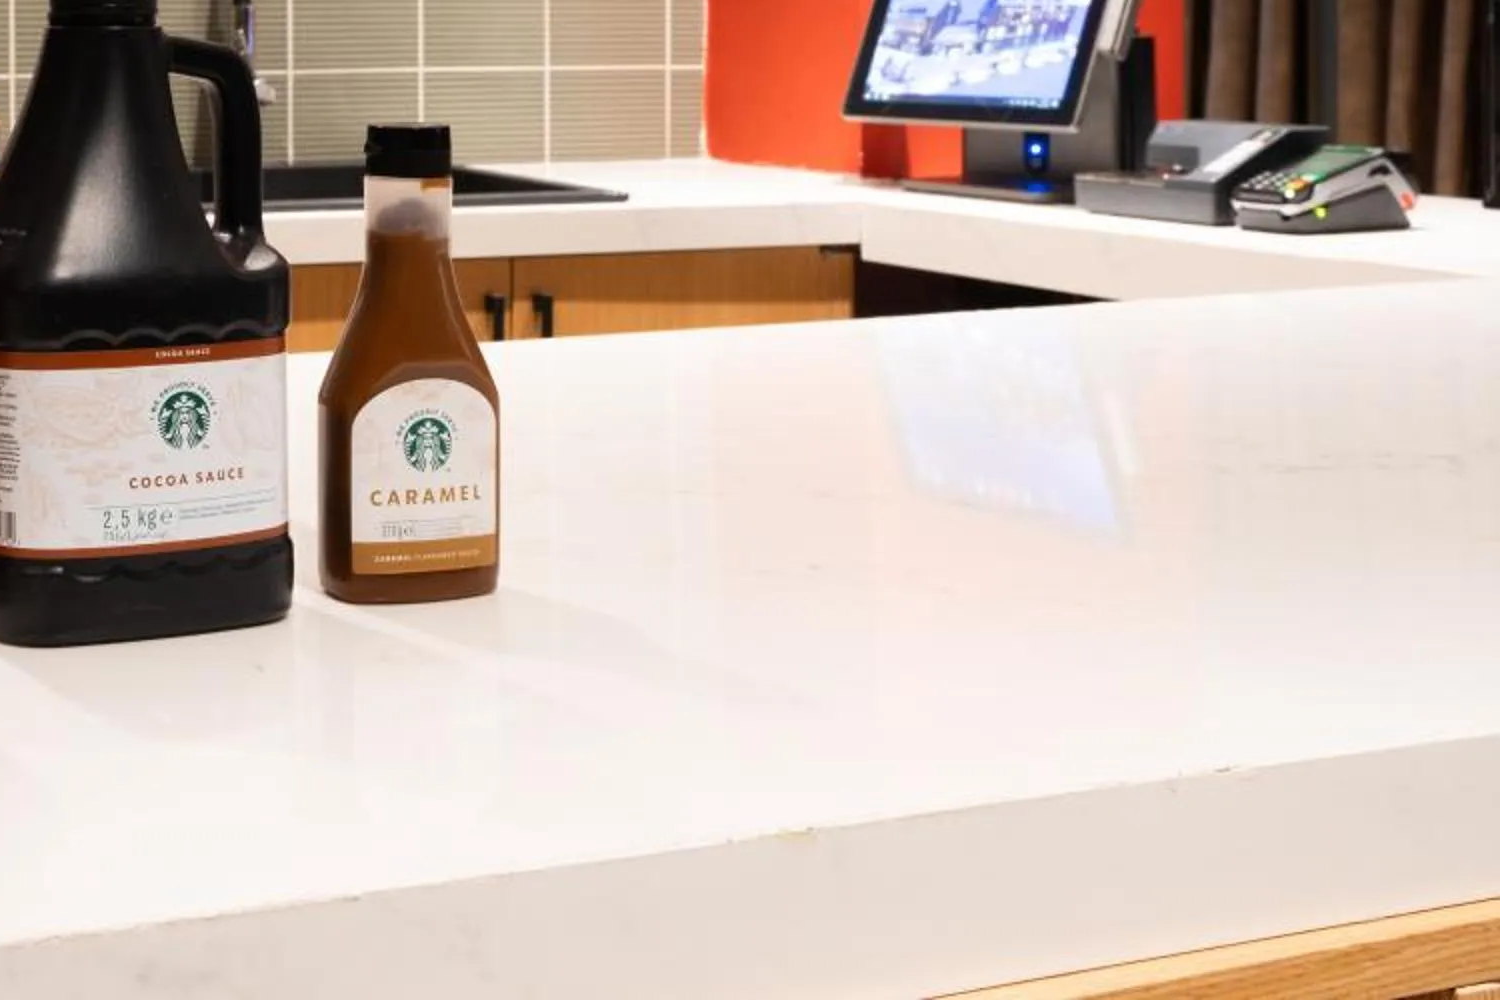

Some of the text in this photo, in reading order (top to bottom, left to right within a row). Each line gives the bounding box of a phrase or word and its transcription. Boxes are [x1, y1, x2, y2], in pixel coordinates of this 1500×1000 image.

[128, 467, 245, 490] COCOA SAUCE
[370, 484, 482, 507] CARAMEL
